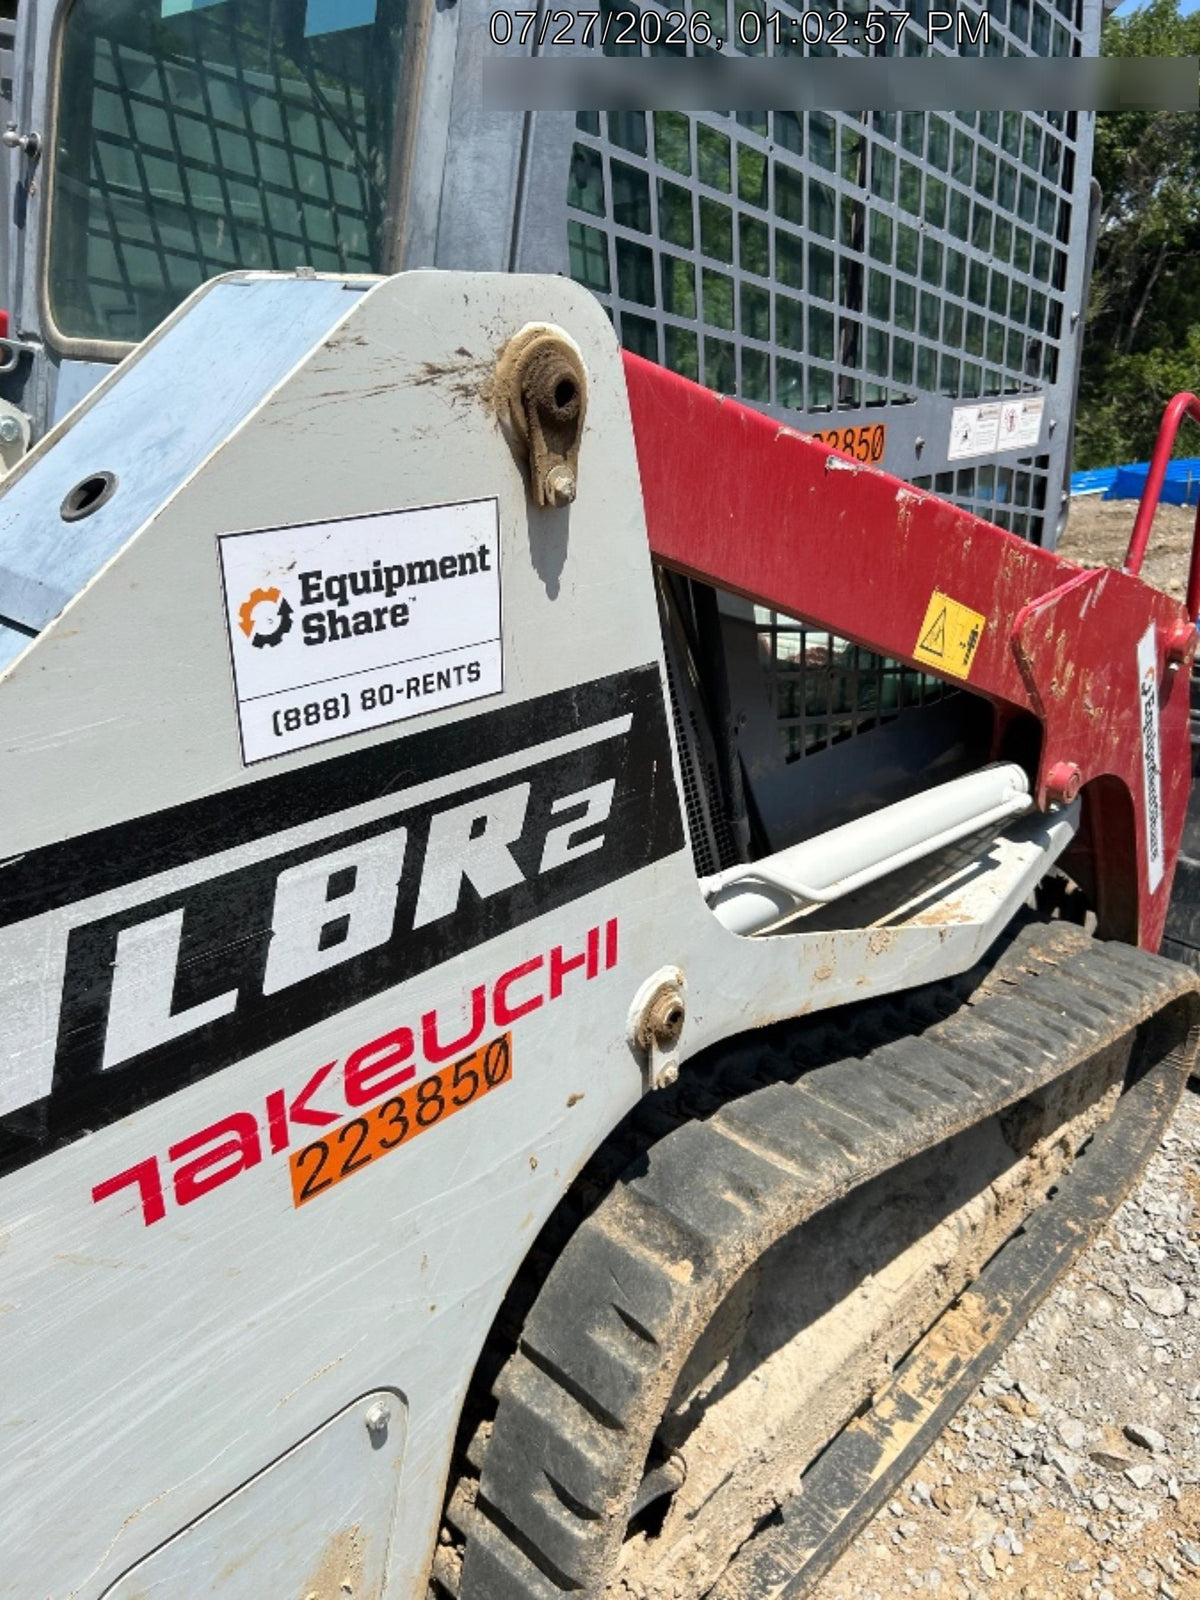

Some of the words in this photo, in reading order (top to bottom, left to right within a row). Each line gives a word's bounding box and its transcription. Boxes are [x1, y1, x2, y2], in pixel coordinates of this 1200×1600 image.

[299, 544, 491, 606] Equipment
[302, 601, 410, 646] Share
[272, 692, 350, 737] (888)
[360, 661, 481, 711] 80-RENTS
[296, 1034, 510, 1201] 223850
